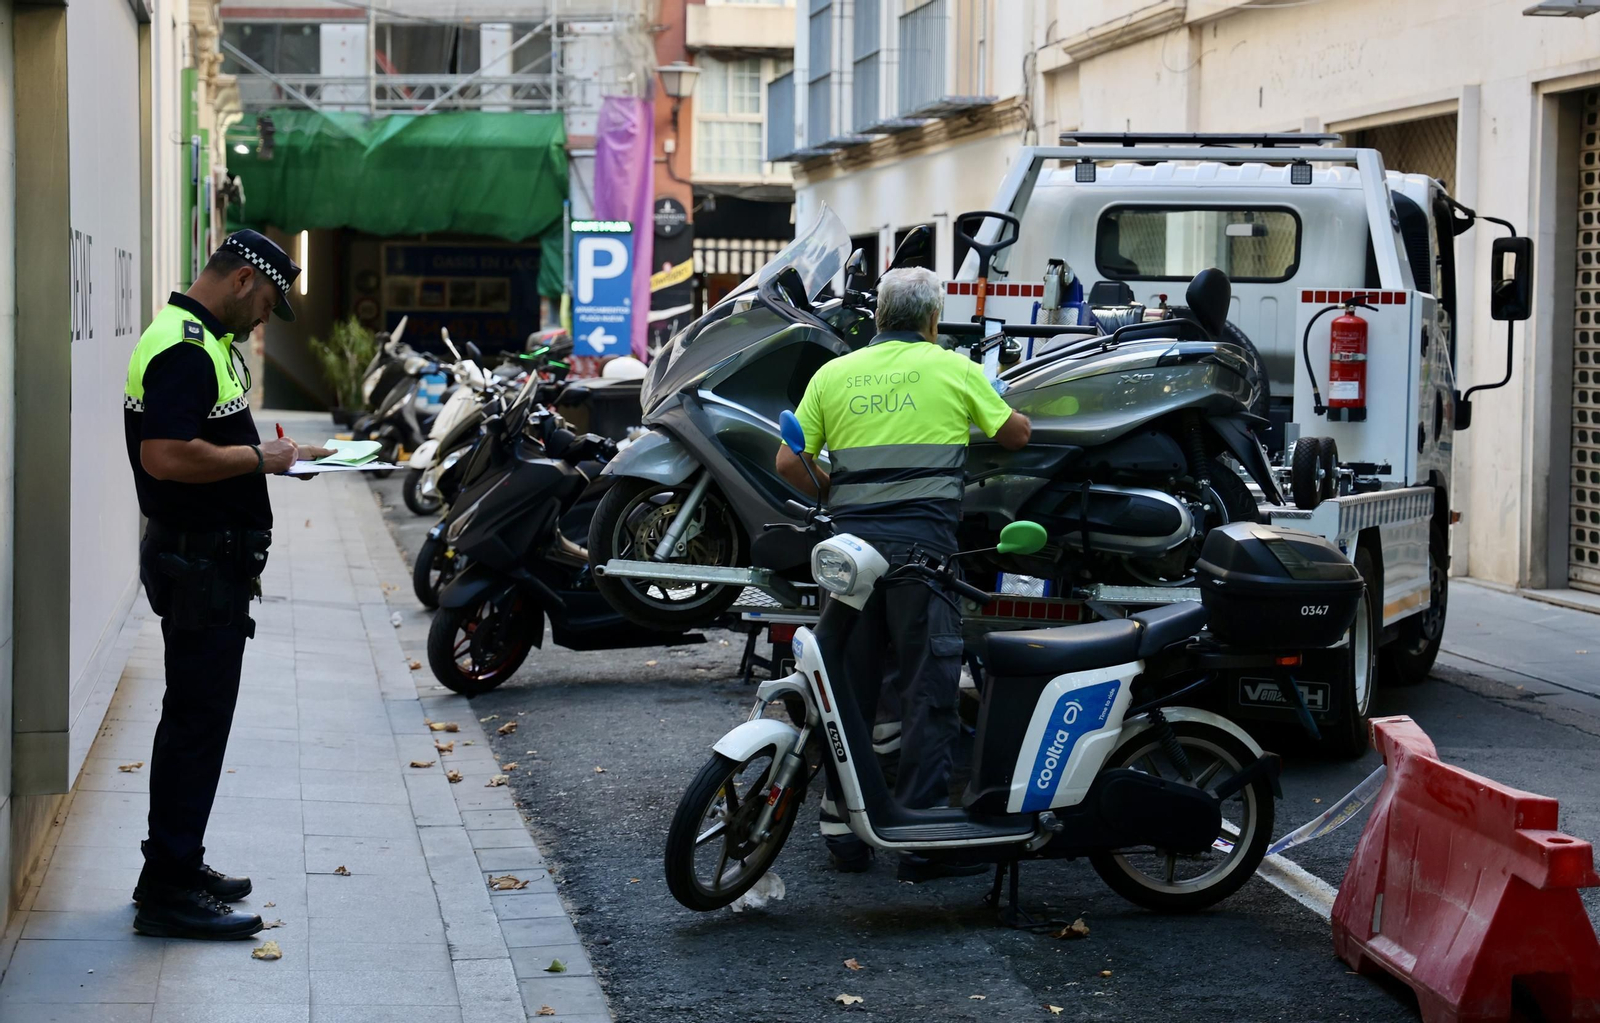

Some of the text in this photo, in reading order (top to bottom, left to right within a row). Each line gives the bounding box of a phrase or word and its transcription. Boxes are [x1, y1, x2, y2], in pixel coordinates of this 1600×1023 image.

[577, 236, 629, 304] P
[846, 370, 921, 389] SERVICIO
[849, 388, 917, 415] GRÚA
[1301, 605, 1329, 616] 0347
[829, 728, 844, 757] 0347
[1037, 729, 1070, 790] cooltra
